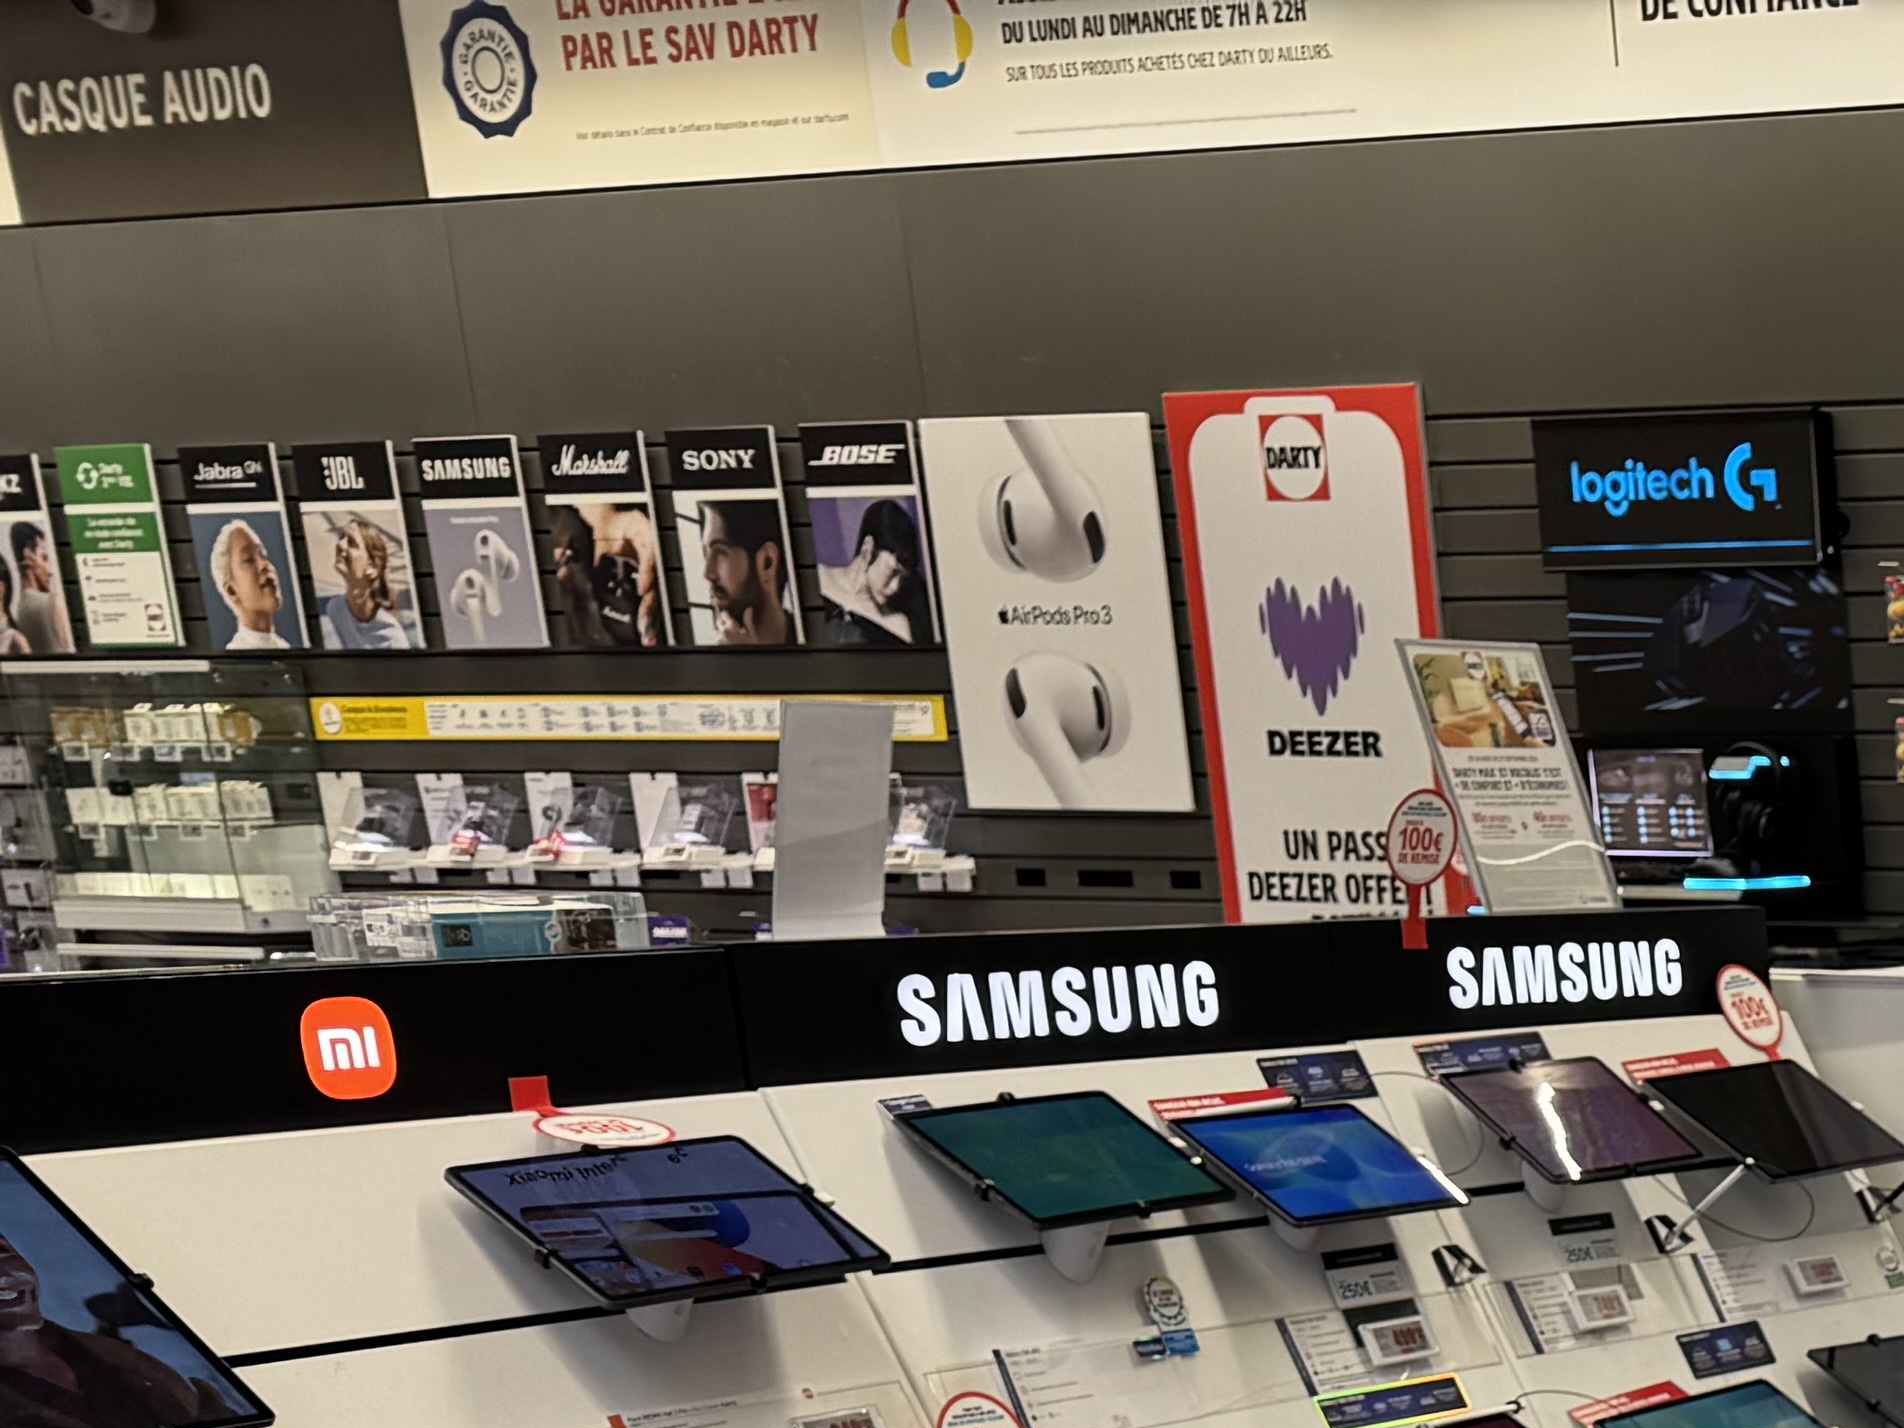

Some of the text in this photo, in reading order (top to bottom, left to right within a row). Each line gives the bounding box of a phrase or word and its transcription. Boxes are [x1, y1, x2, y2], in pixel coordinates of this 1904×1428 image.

[1002, 21, 1024, 44] DU
[1028, 17, 1078, 42] LUNDI
[1082, 14, 1106, 38] AU
[1110, 8, 1198, 36] DIMANCHE
[1202, 6, 1223, 29] DE
[1226, 4, 1250, 27] 7H
[1273, 0, 1306, 22] 22H
[1684, 0, 1860, 19] CONFI
[457, 28, 517, 66] GARANTIE
[562, 13, 819, 71] PAR LE SAV DARTY
[1005, 66, 1027, 82] SUR
[1028, 64, 1058, 80] TOUS
[1060, 62, 1079, 78] LES
[1081, 58, 1135, 77] PRODUITS
[1137, 52, 1185, 73] ACHETÉS
[1188, 51, 1215, 69] CHEZ
[1218, 48, 1254, 67] DARTY
[1258, 47, 1274, 64] OU
[13, 62, 273, 136] CASQUE AUDIO
[461, 78, 521, 116] GARANTIE
[193, 462, 243, 482] Jabra
[420, 455, 512, 483] SAMSUNG
[551, 443, 631, 478] Marshall
[680, 448, 757, 472] SONY
[807, 443, 906, 467] BOSE
[1265, 444, 1323, 471] DARTY
[324, 455, 364, 490] JBL
[1569, 441, 1778, 518] logitech G
[1010, 603, 1114, 627] AirPods Pro 3
[1267, 730, 1383, 757] DEEZER
[1283, 829, 1389, 862] UN PASS
[1398, 826, 1445, 852] 100€
[1247, 871, 1339, 903] DEEZER
[1446, 938, 1683, 1010] SAMSUNG
[896, 959, 1220, 1047] SAMSUNG
